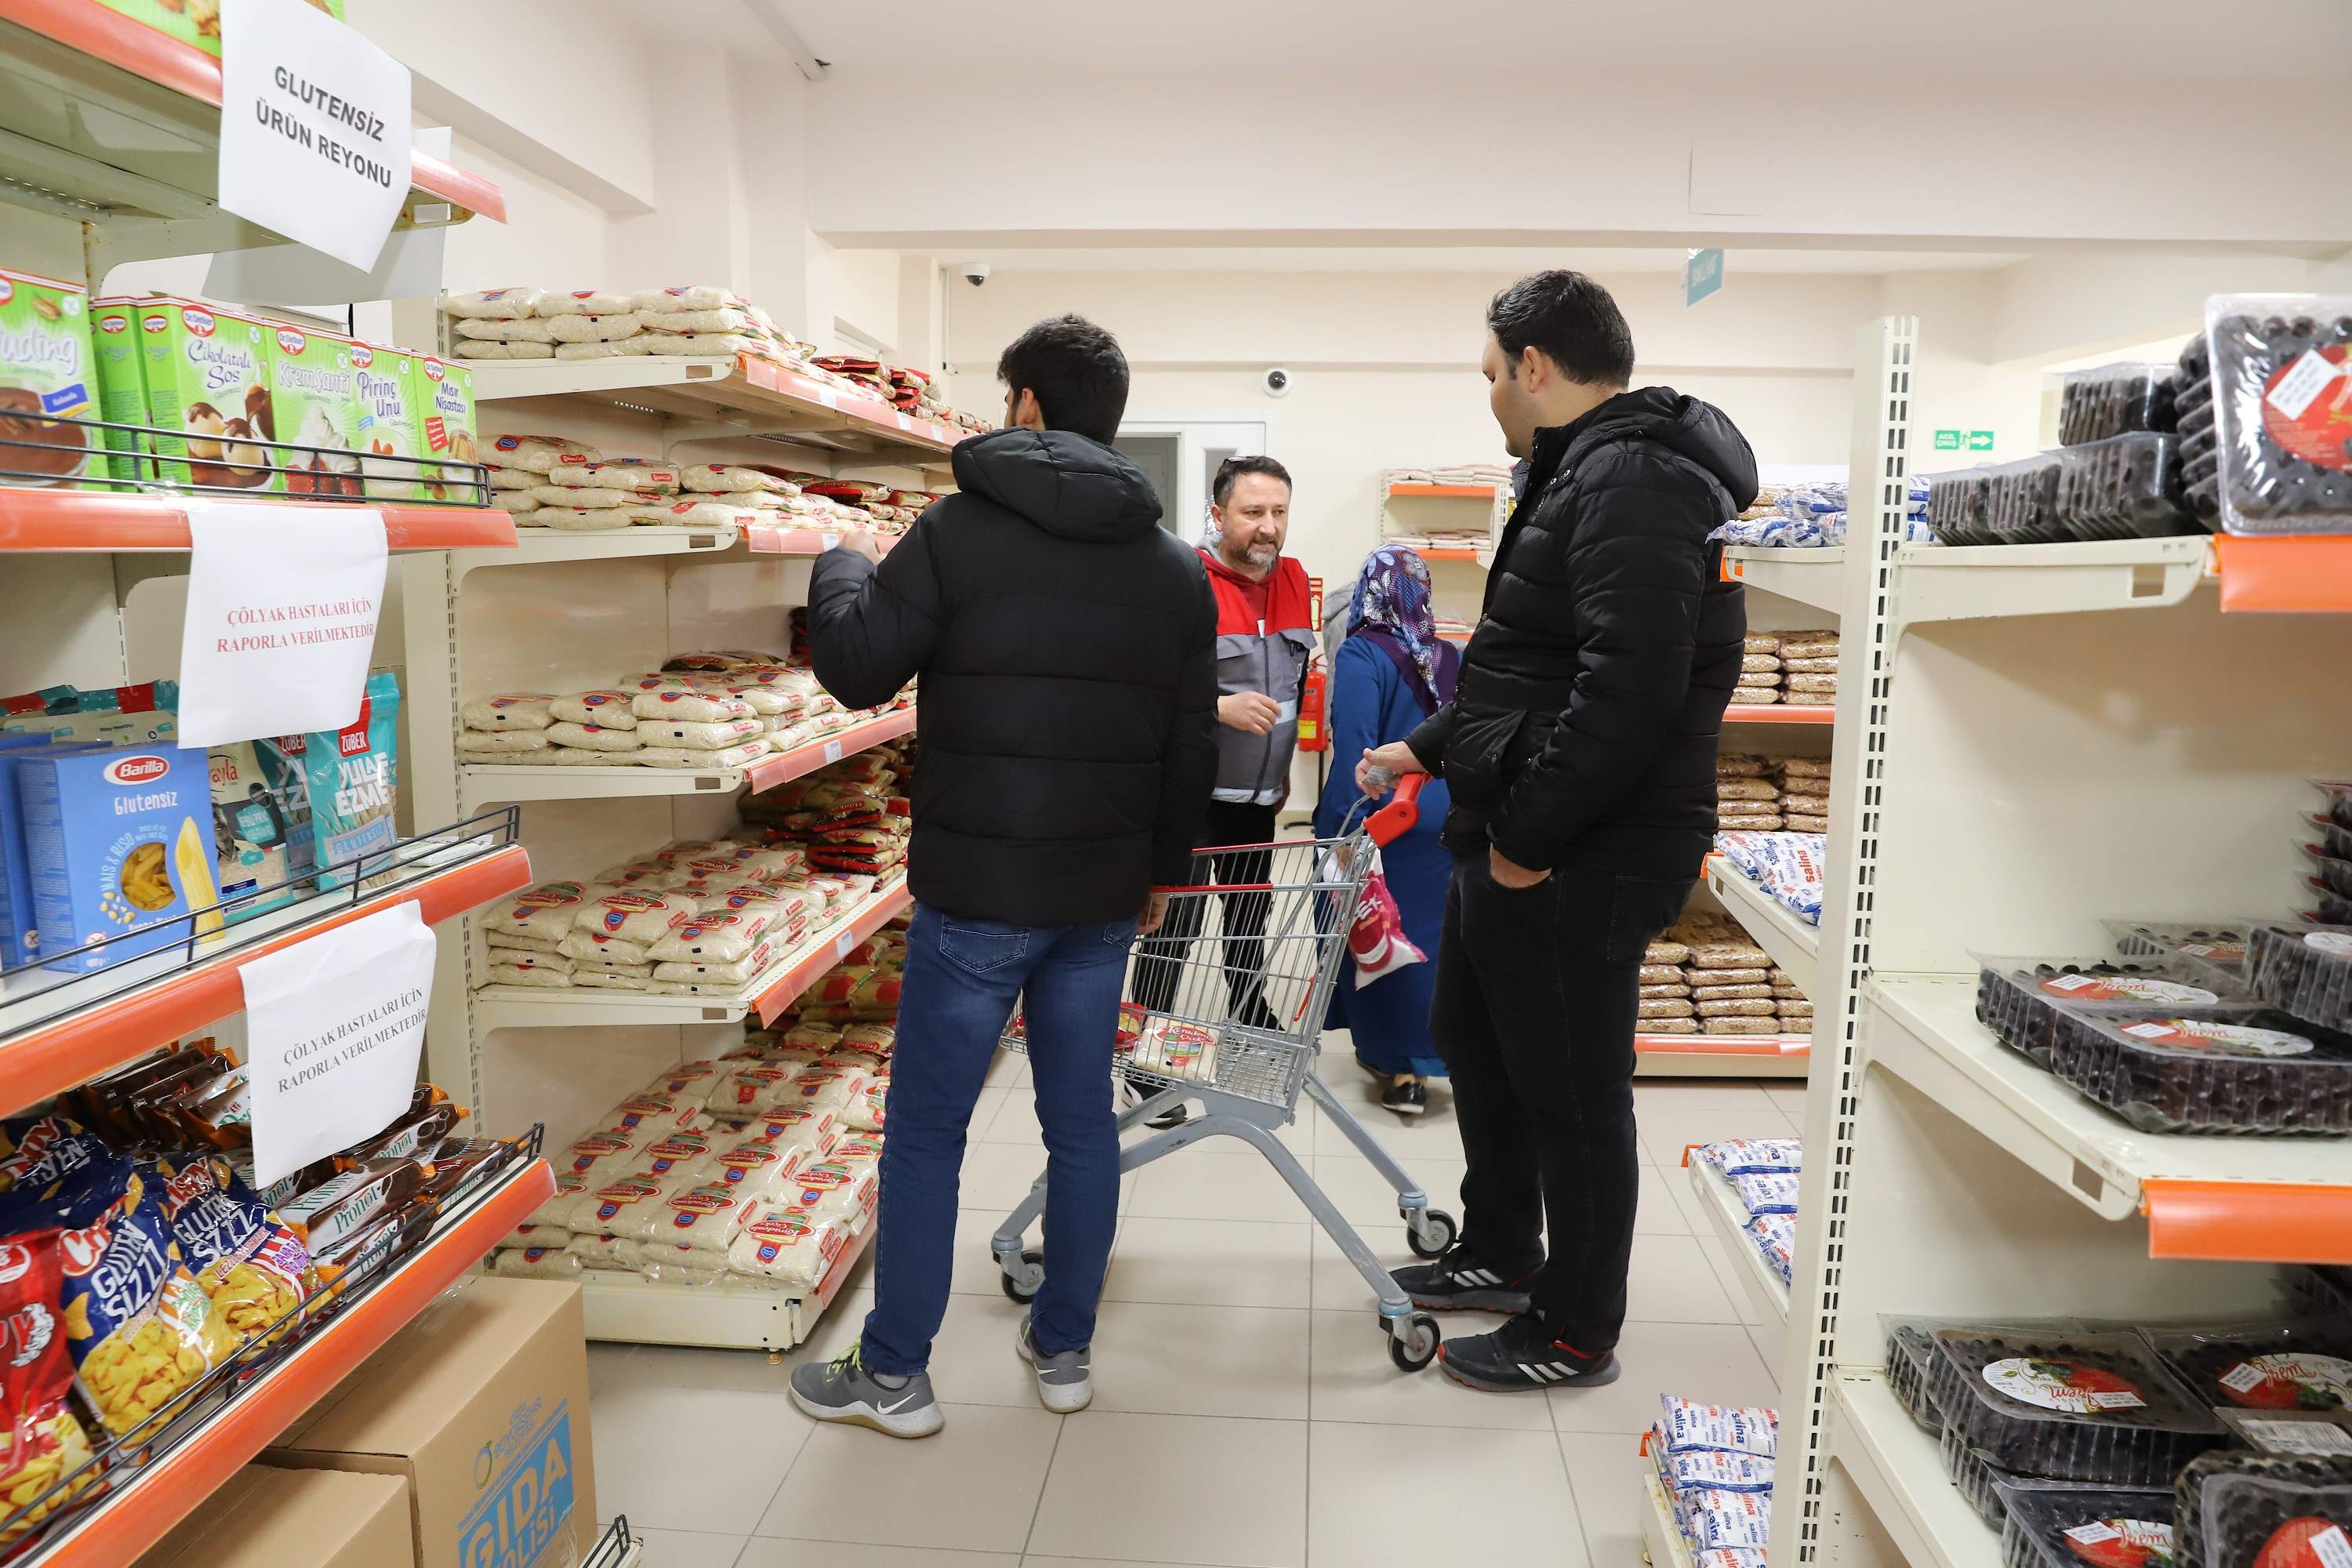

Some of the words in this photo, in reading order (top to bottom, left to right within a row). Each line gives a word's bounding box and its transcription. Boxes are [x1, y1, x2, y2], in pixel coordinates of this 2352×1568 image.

[275, 66, 385, 142] GLUTENSİZ
[256, 96, 311, 148] ÜRÜN
[318, 133, 391, 187] REYONU
[0, 325, 77, 376] uding
[187, 339, 251, 368] Çikolatalı
[206, 365, 240, 389] Sos
[357, 372, 396, 401] Pirinç
[376, 398, 401, 418] Unu
[227, 607, 286, 628] ÇÖLYAK
[289, 601, 350, 620] HASTALARI
[351, 597, 372, 616] İÇİN
[216, 635, 288, 652] RAPORLA
[291, 622, 375, 645] VERİLMEKTEDİR
[341, 731, 367, 753] ZÜBER
[119, 759, 164, 779] Barilla
[211, 758, 238, 786] ayla
[338, 752, 389, 789] YULAF
[114, 791, 178, 815] Glutensiz
[335, 782, 389, 816] EZME
[1797, 850, 1815, 883] salina
[284, 1029, 336, 1065] ÇÖLYAK
[337, 999, 399, 1039] HASTALARI
[401, 986, 423, 1007] İÇİN
[278, 1055, 340, 1093] RAPORLA
[342, 1007, 427, 1061] VERİLMEKTEDİR
[333, 1185, 382, 1233] Pronot
[750, 1225, 800, 1236] Karadeniz
[91, 1218, 147, 1299] GLUTEN
[1675, 1408, 1686, 1439] salina
[1731, 1413, 1746, 1444] salina
[1749, 1523, 1759, 1543] salina
